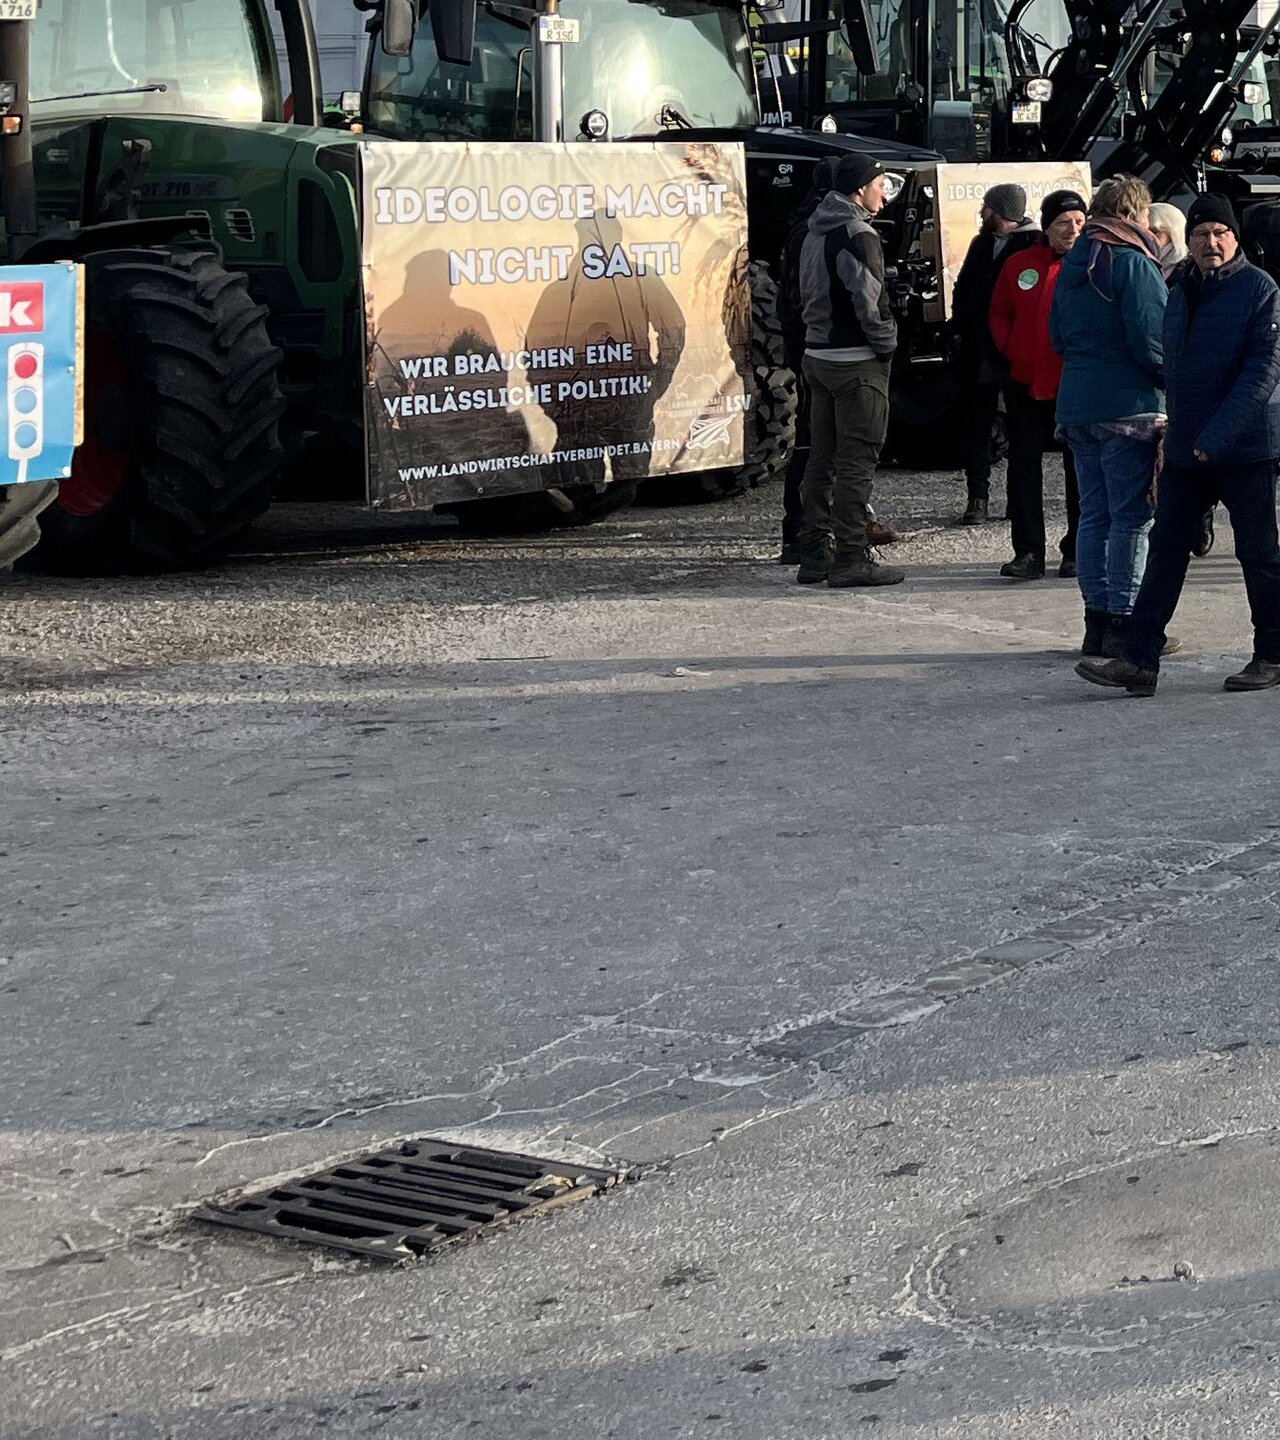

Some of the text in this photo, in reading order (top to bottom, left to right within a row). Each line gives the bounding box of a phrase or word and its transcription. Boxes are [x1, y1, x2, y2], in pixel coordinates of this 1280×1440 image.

[8, 5, 32, 17] 716
[374, 183, 728, 224] IDEOLOGIE MACHT
[450, 241, 682, 286] NICHT SATT!
[399, 342, 634, 380] WIR BRAUCHEN EINE
[383, 374, 651, 418] VERLÄSSLICHE POLITIK!
[726, 393, 752, 413] LSV
[398, 437, 682, 483] WWW.LANDWIRTSCHAFTVERBINDET.BAYERN
